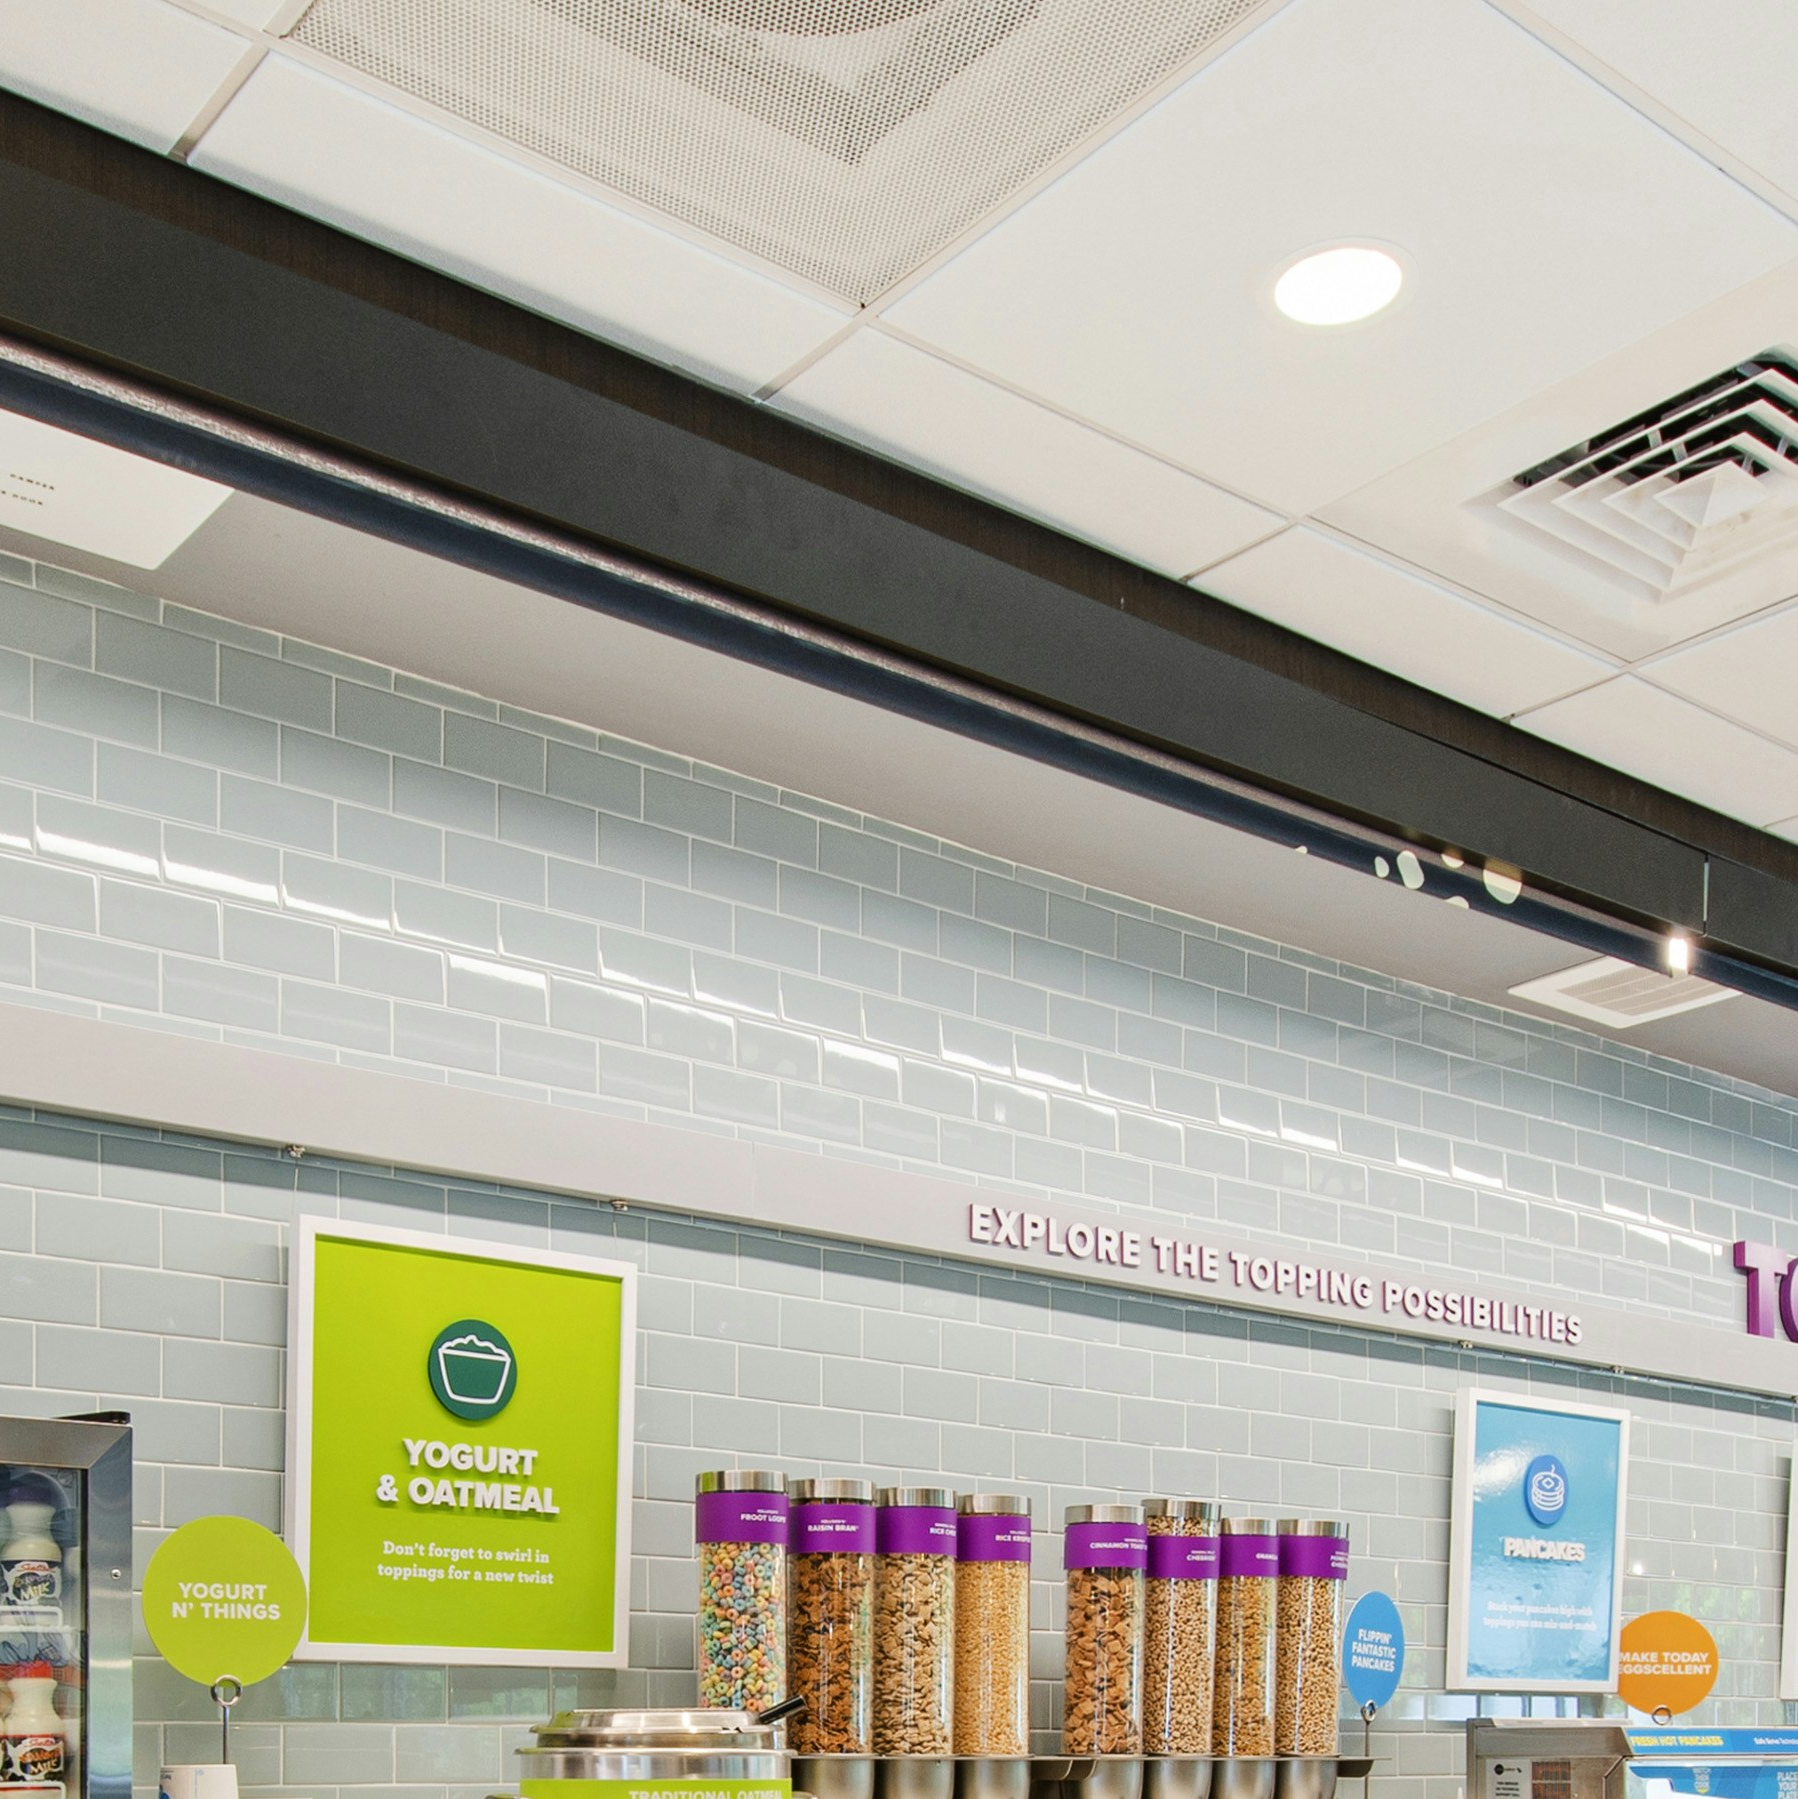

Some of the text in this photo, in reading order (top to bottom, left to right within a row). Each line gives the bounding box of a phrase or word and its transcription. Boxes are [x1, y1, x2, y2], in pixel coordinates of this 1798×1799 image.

[969, 1203, 1583, 1344] EXPLORE THE TOPPING POSSIBILITIES
[403, 1438, 538, 1476] YOGURT
[376, 1474, 560, 1514] & OATMEAL
[428, 1543, 474, 1561] forget
[477, 1548, 492, 1559] to
[496, 1549, 532, 1562] swirl
[535, 1550, 549, 1563] in
[1504, 1536, 1586, 1561] PANCAKES
[377, 1564, 554, 1585] toppings for a new twist
[178, 1582, 267, 1600] YOGURT
[200, 1603, 281, 1620] THINGS
[1352, 1641, 1396, 1659] FANTASTIC
[1619, 1652, 1709, 1663] MAKE TODAY
[1352, 1655, 1395, 1672] PANCAKES
[1678, 1735, 1724, 1746] PANCAKES
[1777, 1772, 1798, 1781] PLACE
[1778, 1781, 1797, 1791] YOUR
